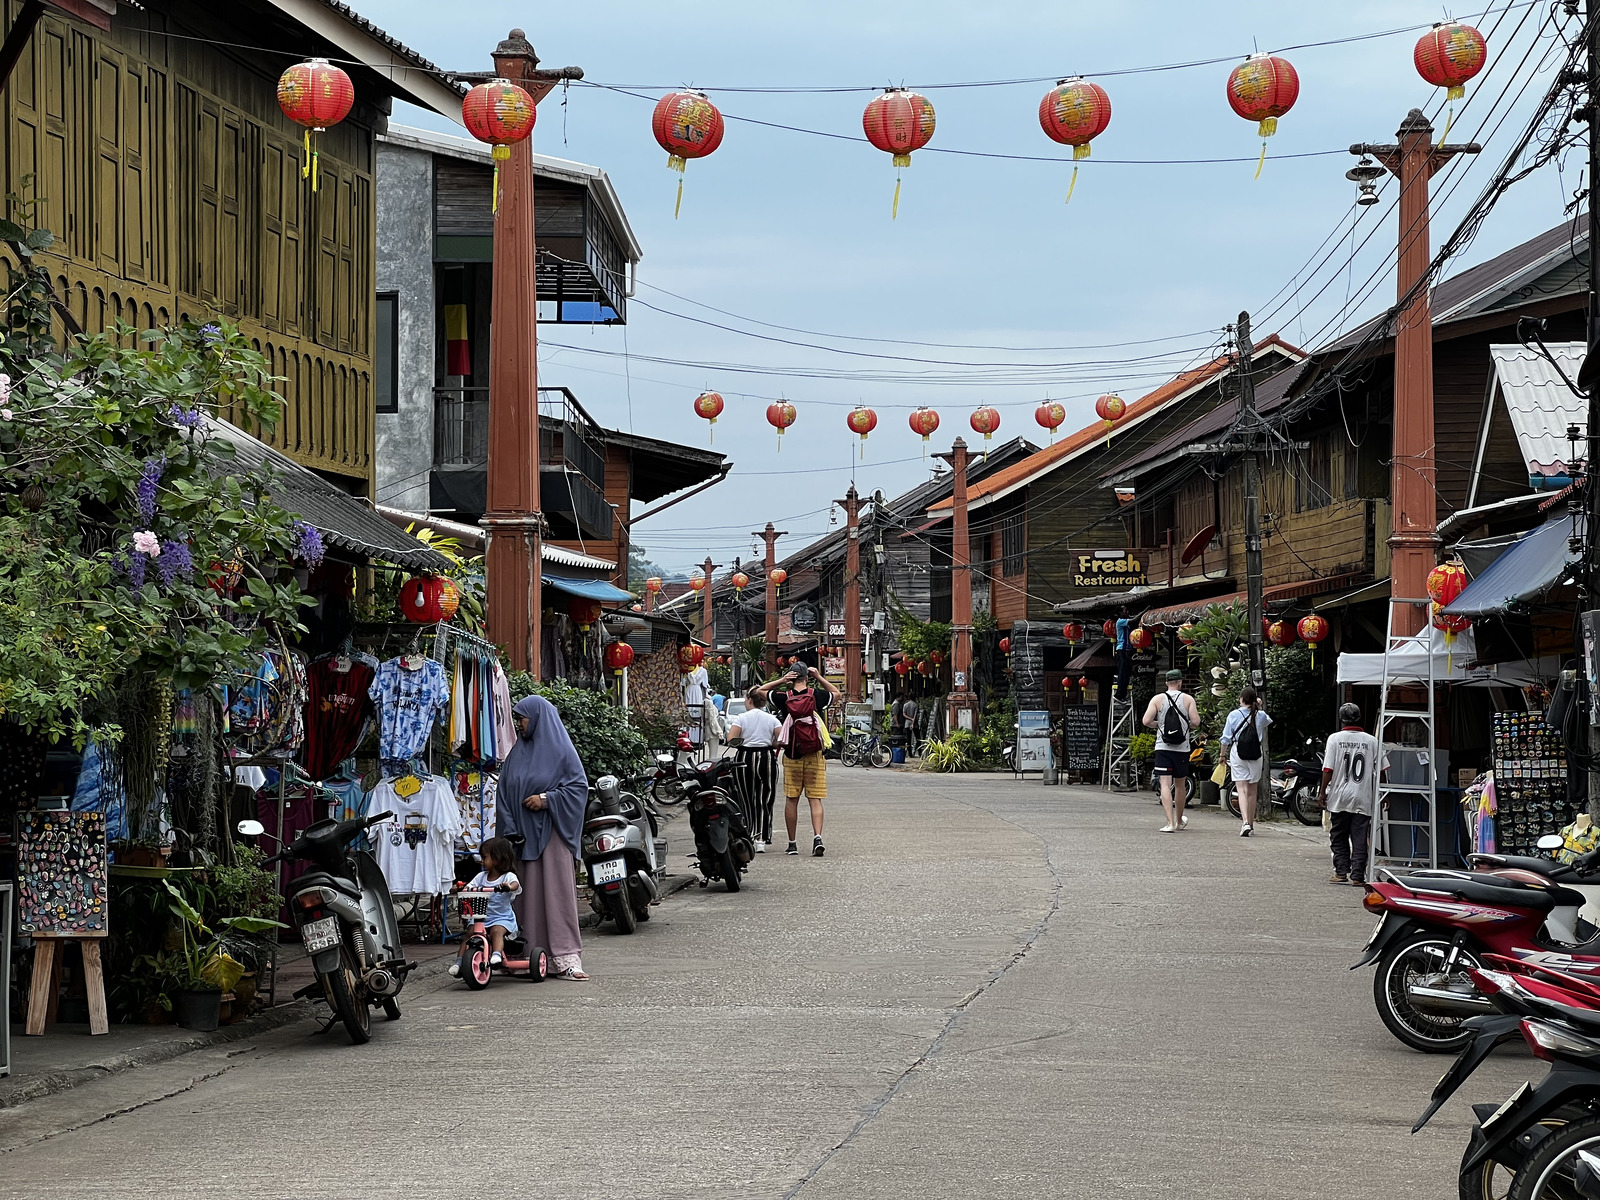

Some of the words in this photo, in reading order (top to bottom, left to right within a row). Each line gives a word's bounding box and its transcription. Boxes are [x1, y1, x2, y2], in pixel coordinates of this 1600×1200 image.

[1078, 553, 1140, 573] Fresh
[1074, 573, 1146, 586] Restaurant
[1344, 752, 1365, 784] 10
[599, 872, 622, 883] 3083
